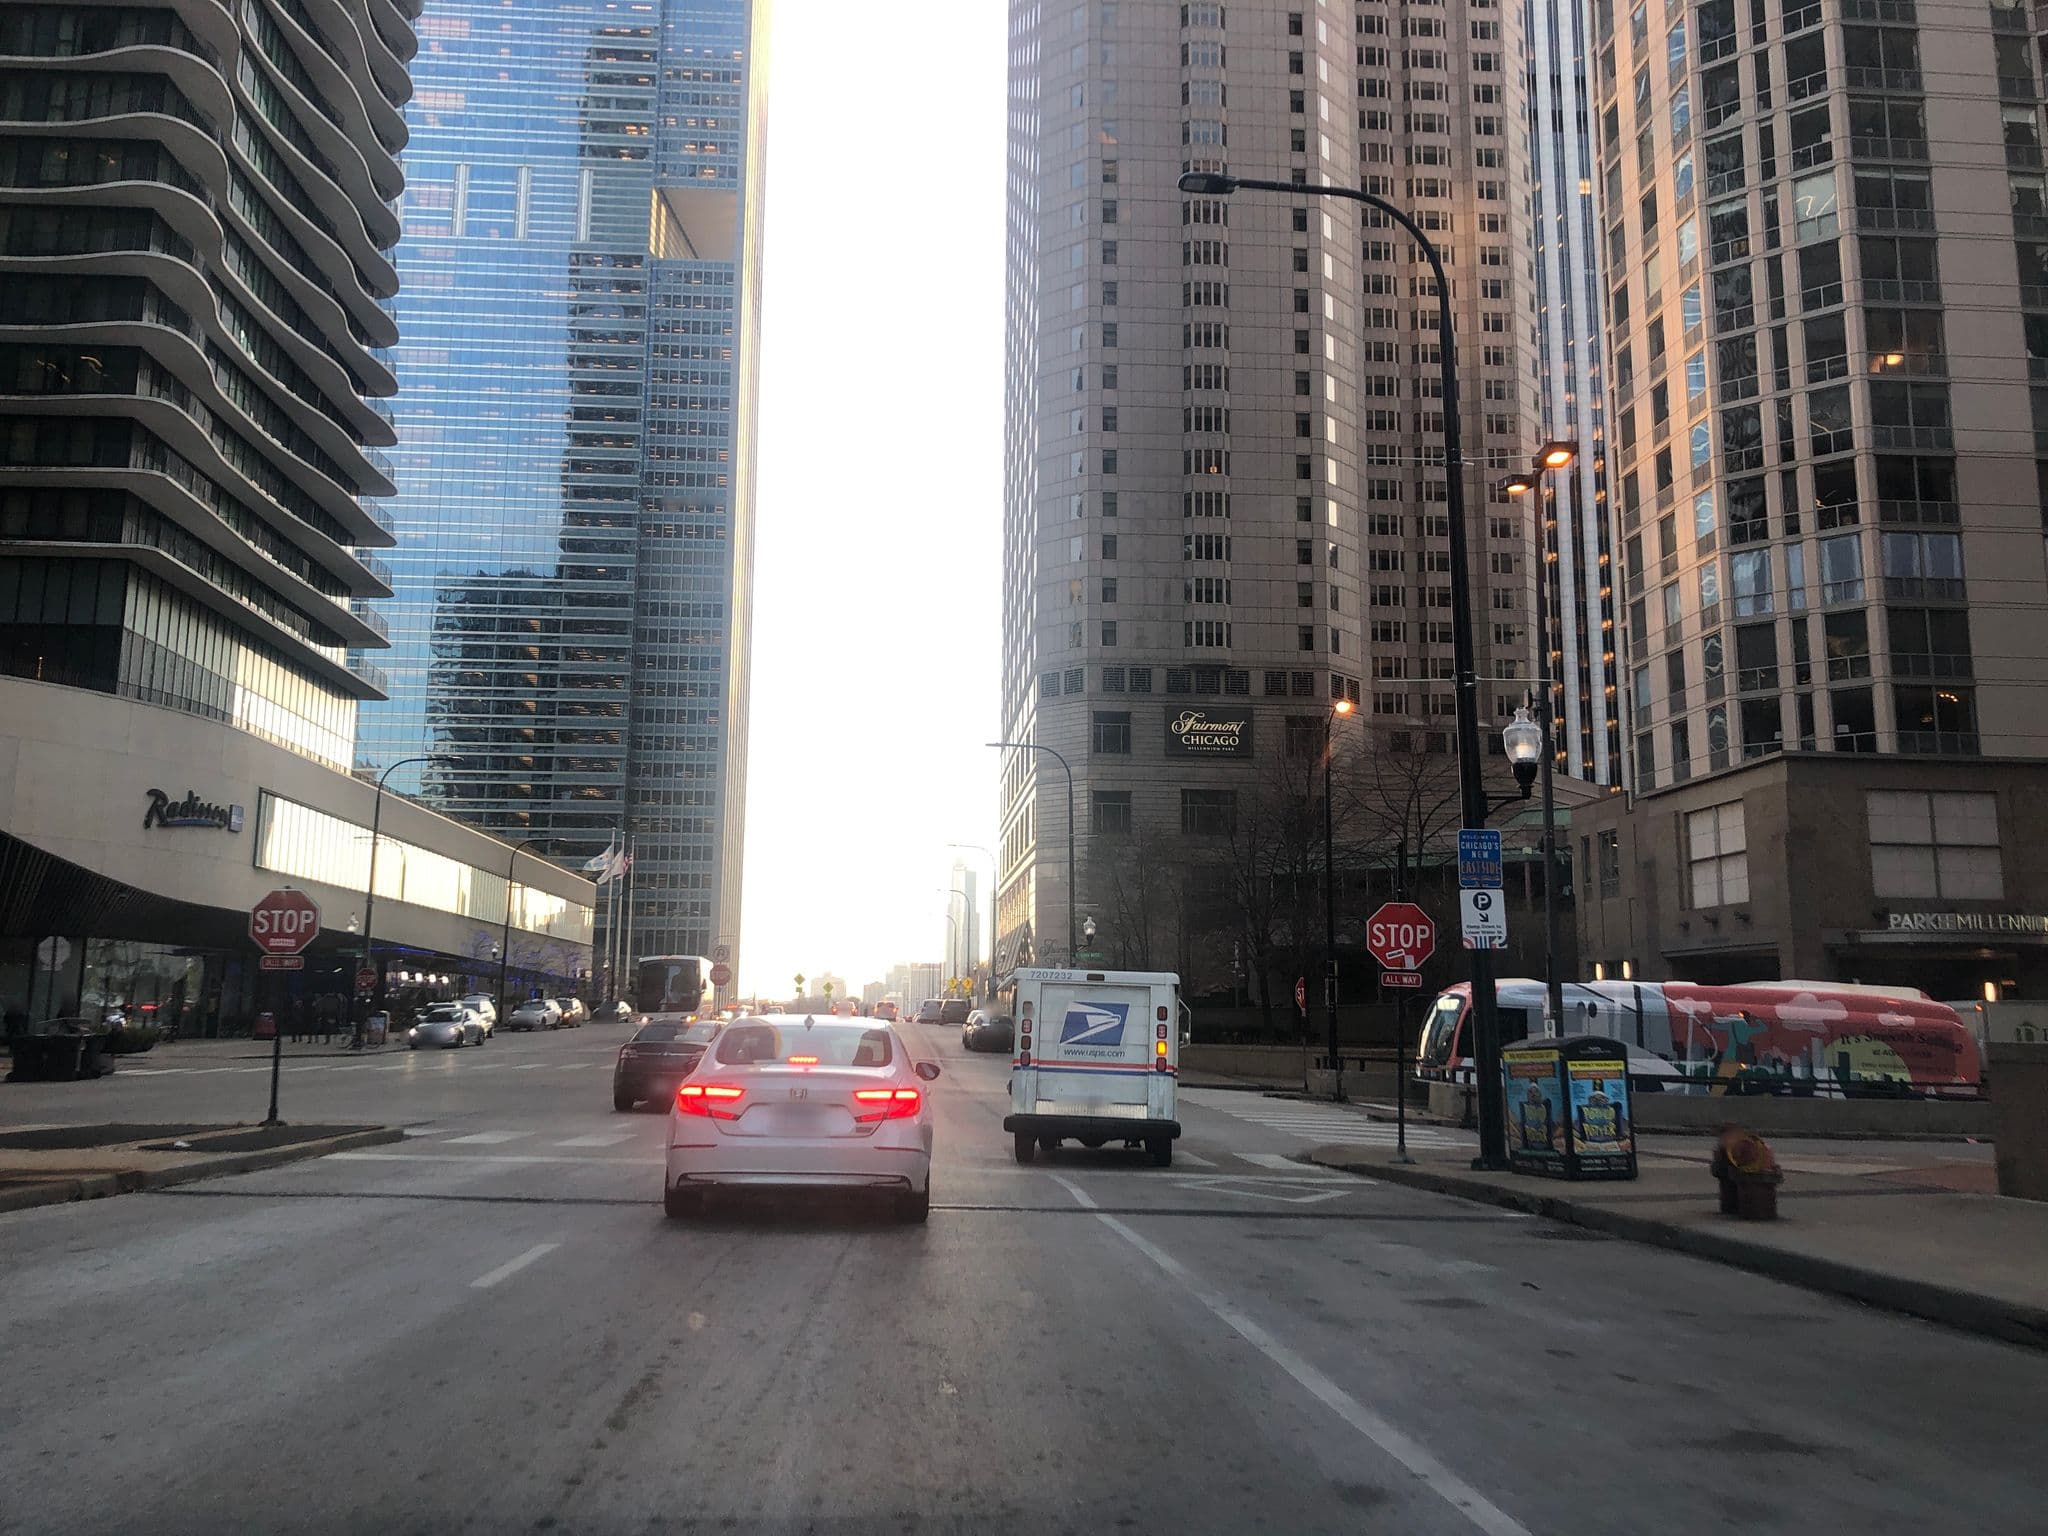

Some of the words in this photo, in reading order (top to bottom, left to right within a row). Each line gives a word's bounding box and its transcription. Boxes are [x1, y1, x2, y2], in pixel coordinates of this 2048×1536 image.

[1171, 711, 1246, 735] Fairmont
[1181, 735, 1239, 746] CHICAGO
[1460, 841, 1499, 850] CHICAGO'S
[1471, 850, 1489, 859] NEW
[255, 909, 315, 934] STOP
[1888, 912, 1938, 931] PARK
[1372, 923, 1430, 949] STOP
[1030, 970, 1073, 980] 7207232
[1385, 975, 1400, 984] ALL
[1402, 976, 1417, 985] WAY
[1064, 1049, 1126, 1059] www.usps.com
